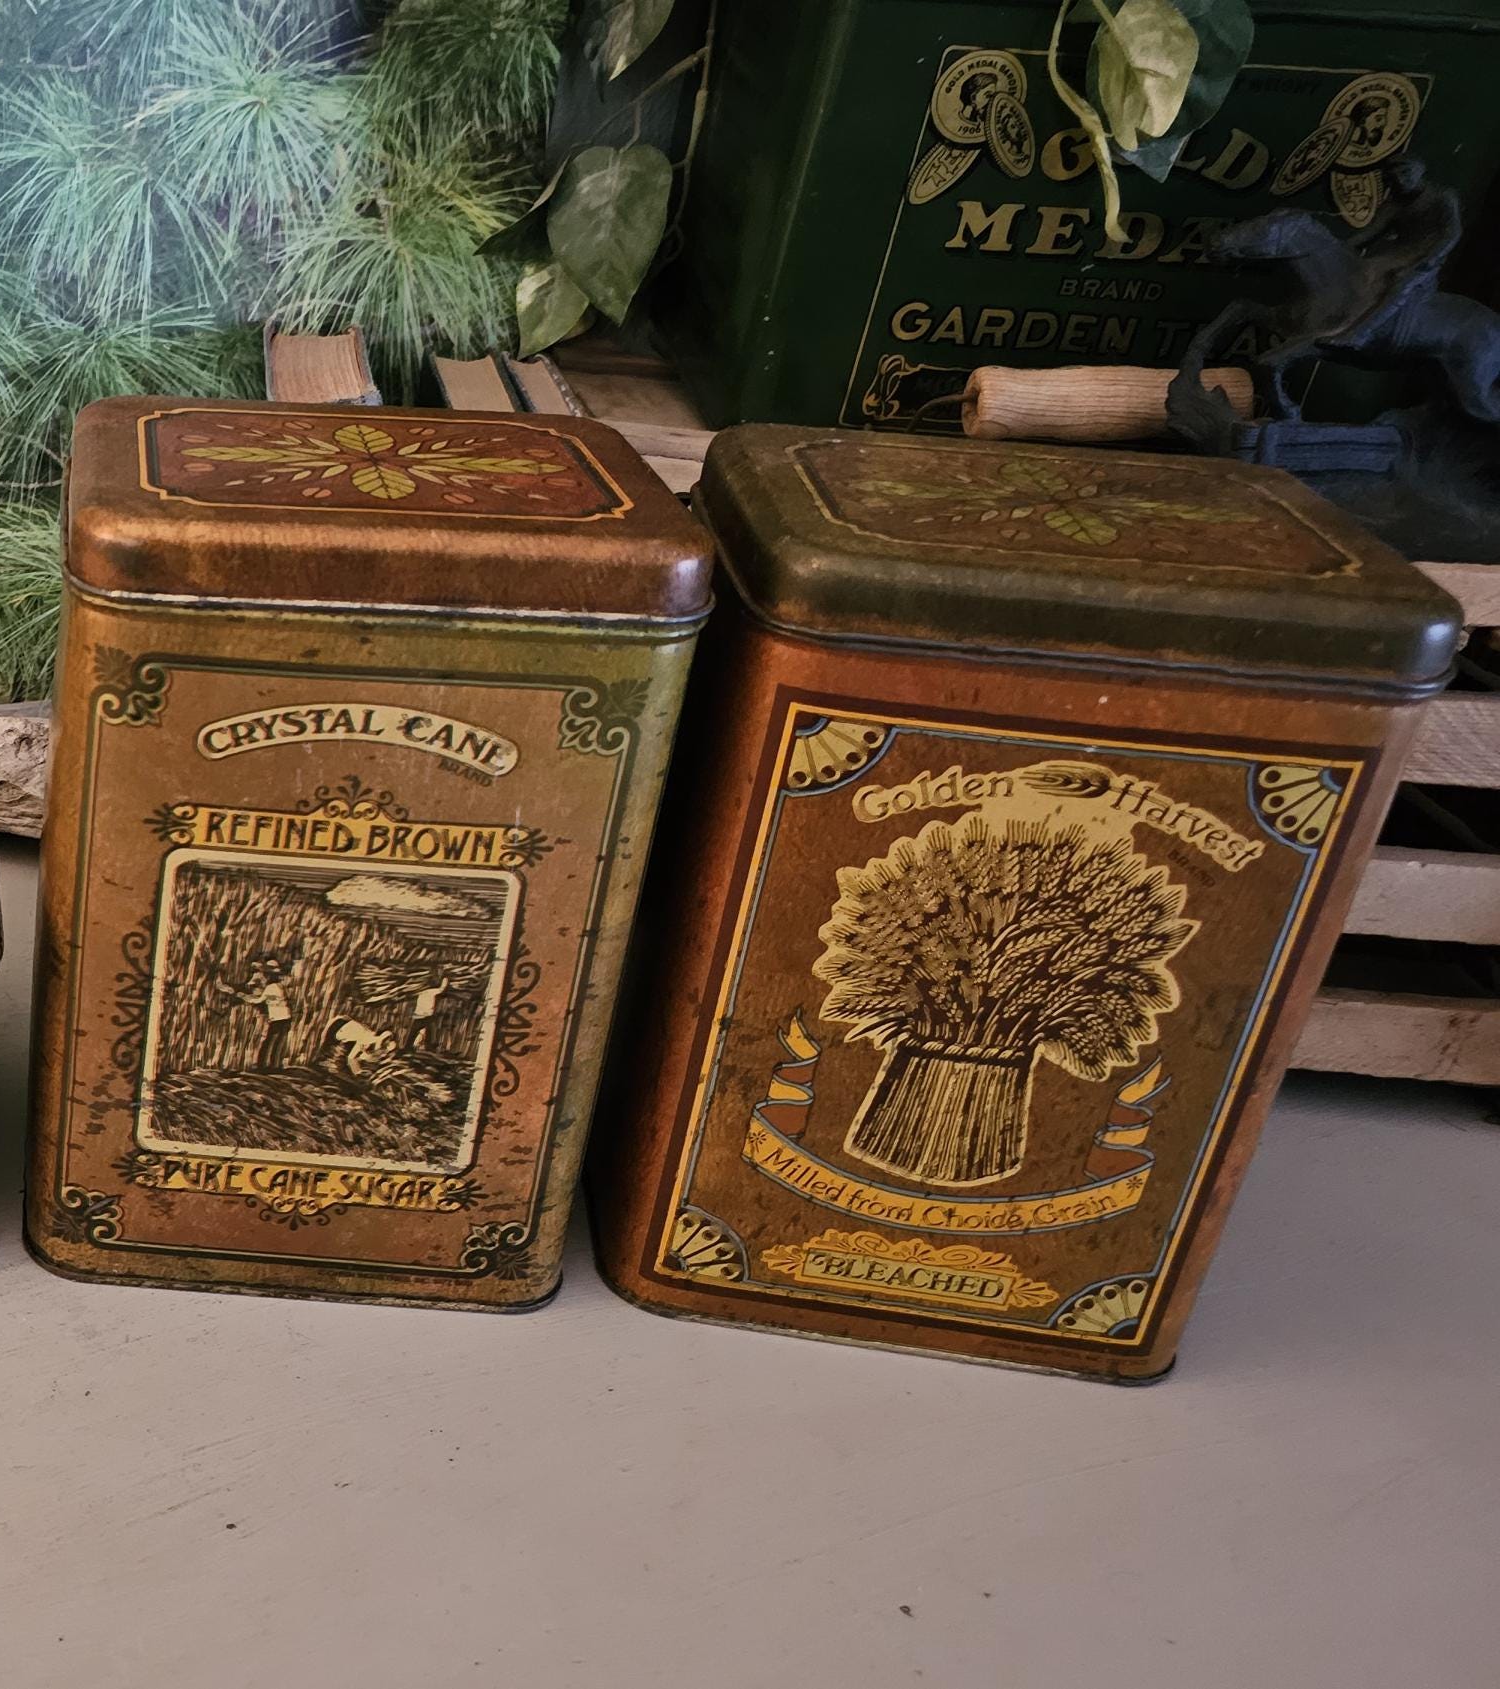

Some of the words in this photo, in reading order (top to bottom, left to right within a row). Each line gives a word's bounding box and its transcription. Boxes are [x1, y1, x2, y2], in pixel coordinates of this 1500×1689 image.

[945, 69, 965, 94] GOLD
[957, 122, 982, 135] 1906
[944, 200, 1214, 264] MEDA
[1059, 277, 1163, 302] BRAND
[891, 301, 1138, 357] GARDEN
[202, 708, 386, 755] CRYSTAL
[398, 714, 509, 773] CANE
[438, 758, 493, 787] BRAND
[204, 811, 354, 853] REFINED
[365, 824, 496, 863] BROWN
[857, 772, 1015, 820] Golden
[1109, 779, 1262, 869] Harvest
[159, 1158, 245, 1193] PURE
[249, 1166, 330, 1198] CANE
[331, 1173, 437, 1208] SUGAR
[763, 1147, 845, 1202] Milled
[846, 1190, 913, 1222] from
[921, 1203, 1025, 1229] Choice
[1031, 1193, 1118, 1227] Grain
[810, 1252, 1006, 1300] BLEACHED
